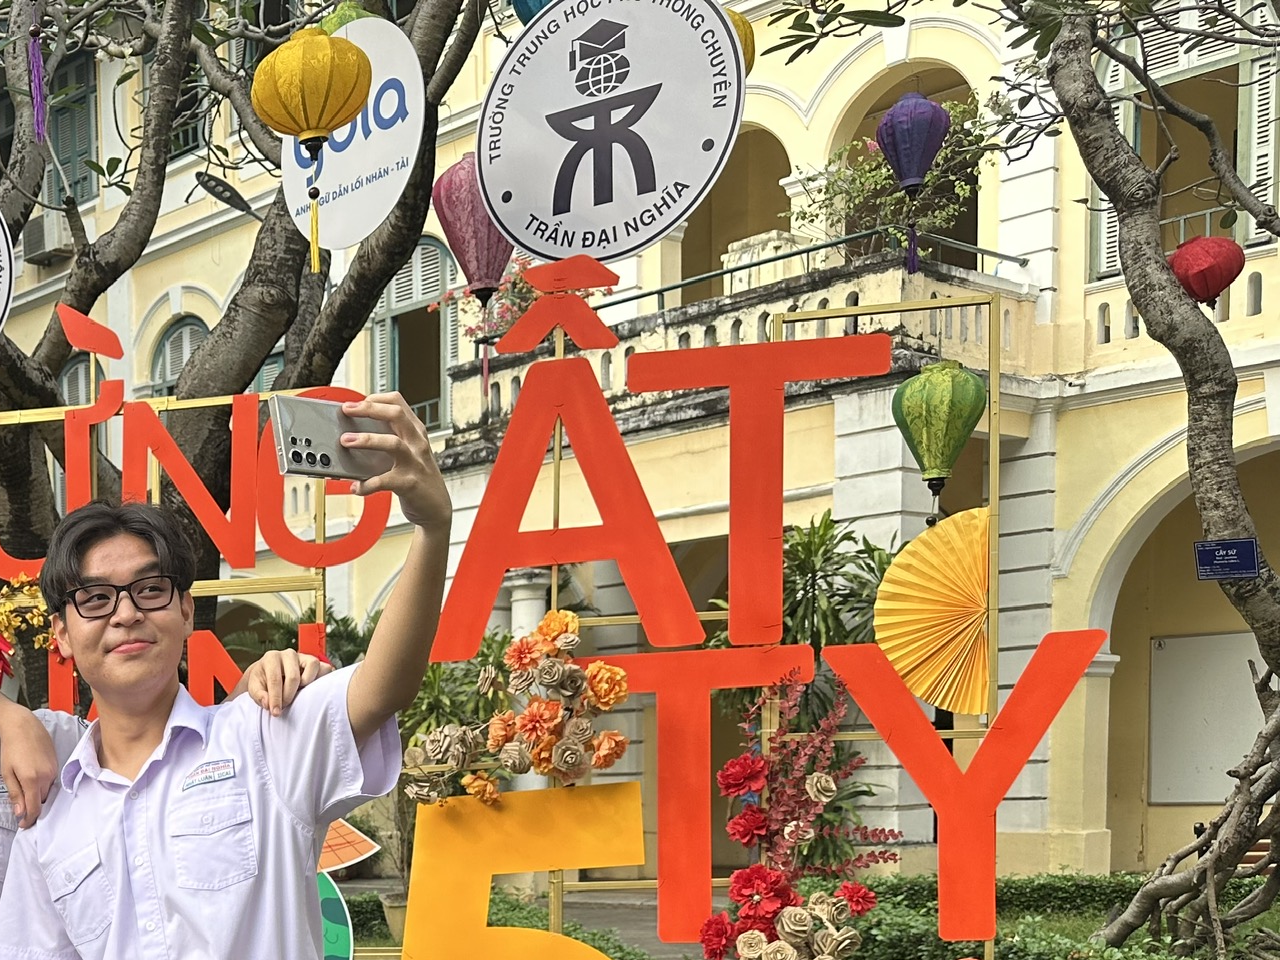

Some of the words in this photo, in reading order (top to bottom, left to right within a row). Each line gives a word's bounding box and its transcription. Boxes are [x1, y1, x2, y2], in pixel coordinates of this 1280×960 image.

[489, 82, 515, 164] TRƯỜNG
[509, 19, 561, 76] TRUNG
[700, 29, 732, 109] CHUYÊN
[332, 184, 350, 201] DẪN
[351, 176, 364, 193] LỐI
[366, 168, 389, 188] NHÂN
[395, 157, 409, 173] TÀI
[524, 213, 576, 248] TRẦN
[582, 226, 617, 249] ĐẠI
[624, 180, 691, 237] NGHĨA
